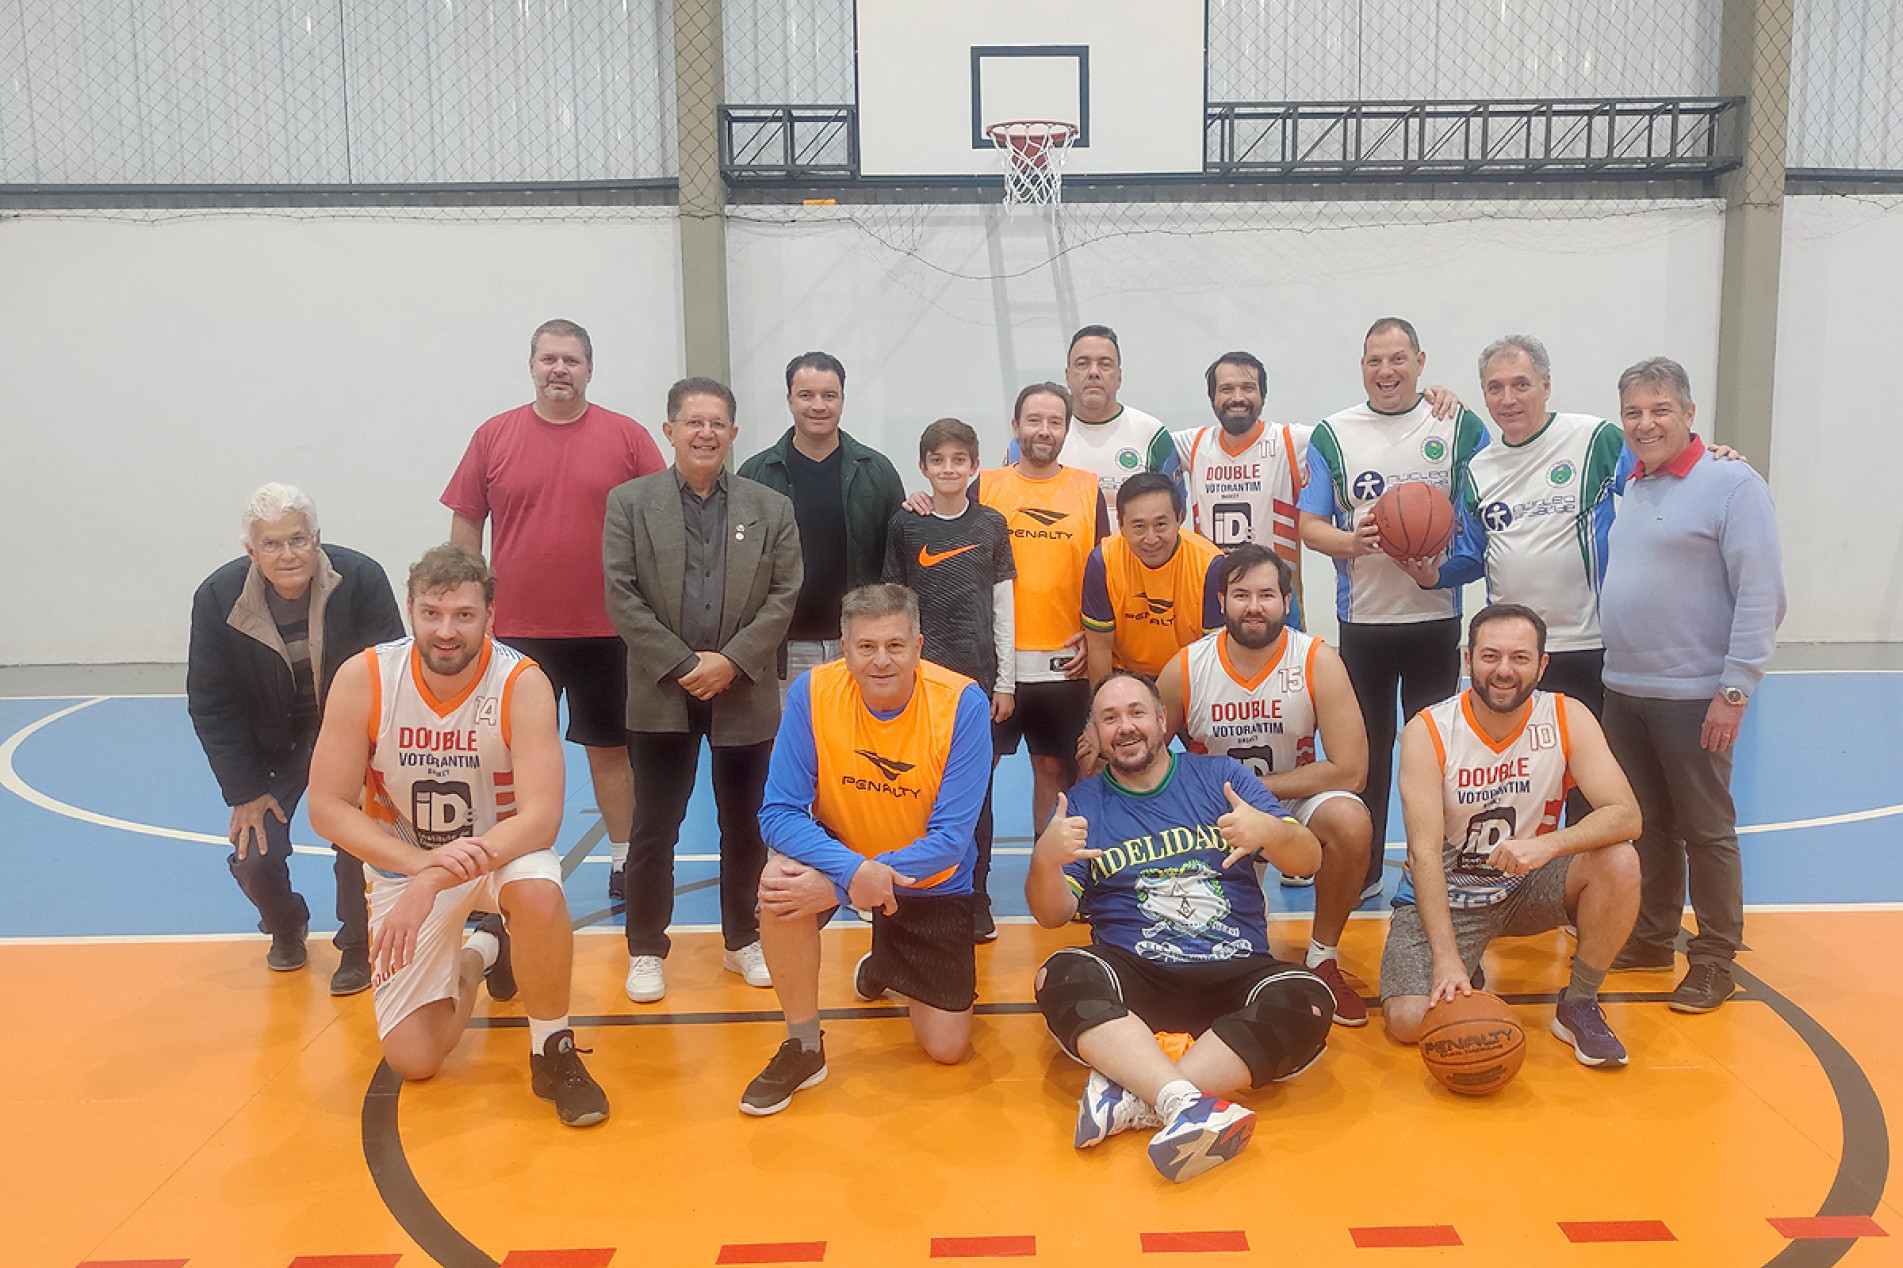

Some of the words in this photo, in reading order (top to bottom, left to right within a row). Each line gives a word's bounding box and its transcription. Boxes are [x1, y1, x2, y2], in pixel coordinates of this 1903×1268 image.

[1206, 464, 1261, 480] DOUBLE
[1205, 481, 1262, 494] VOTORANTIM
[1008, 528, 1073, 540] PENALTY
[1125, 611, 1176, 627] PENALT
[1279, 666, 1304, 693] 15
[475, 695, 498, 726] 14
[1211, 699, 1282, 722] DOUBLE
[399, 726, 478, 752] DOUBLE
[1212, 722, 1284, 738] VOTORANTIM
[1528, 723, 1557, 751] 10
[399, 752, 480, 768] VOTORANTIM
[1457, 757, 1530, 788] DOUBLE
[841, 775, 921, 799] PENALTY
